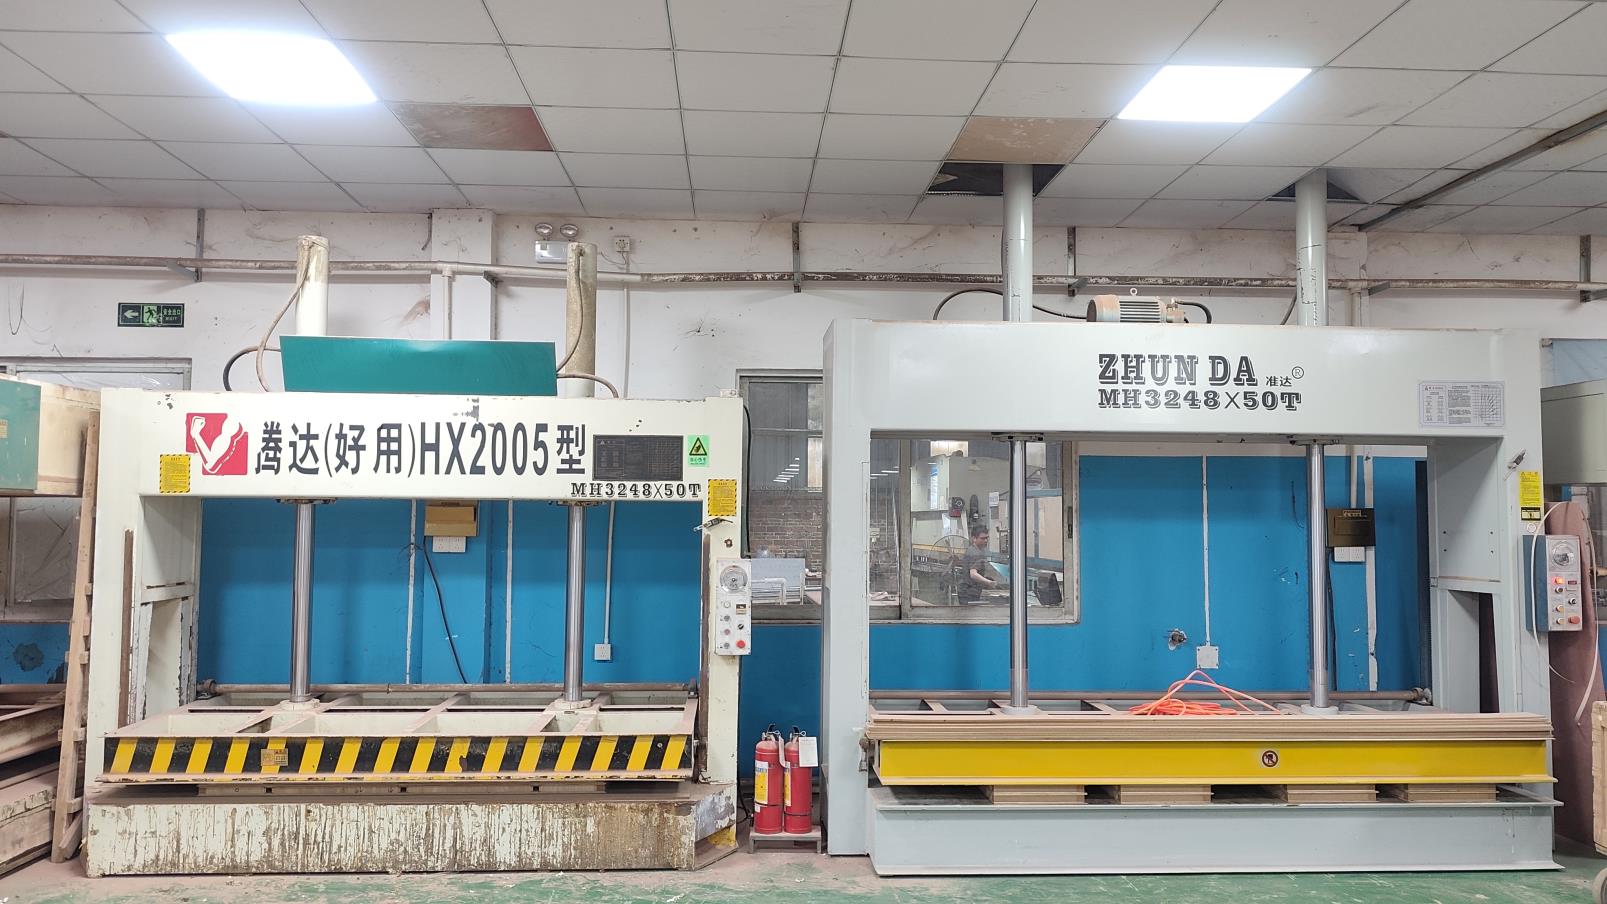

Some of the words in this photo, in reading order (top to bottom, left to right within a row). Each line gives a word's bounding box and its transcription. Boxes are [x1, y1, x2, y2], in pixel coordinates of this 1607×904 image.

[1098, 353, 1199, 386] ZHUN
[1208, 355, 1258, 387] DA
[1265, 375, 1292, 387] 准达
